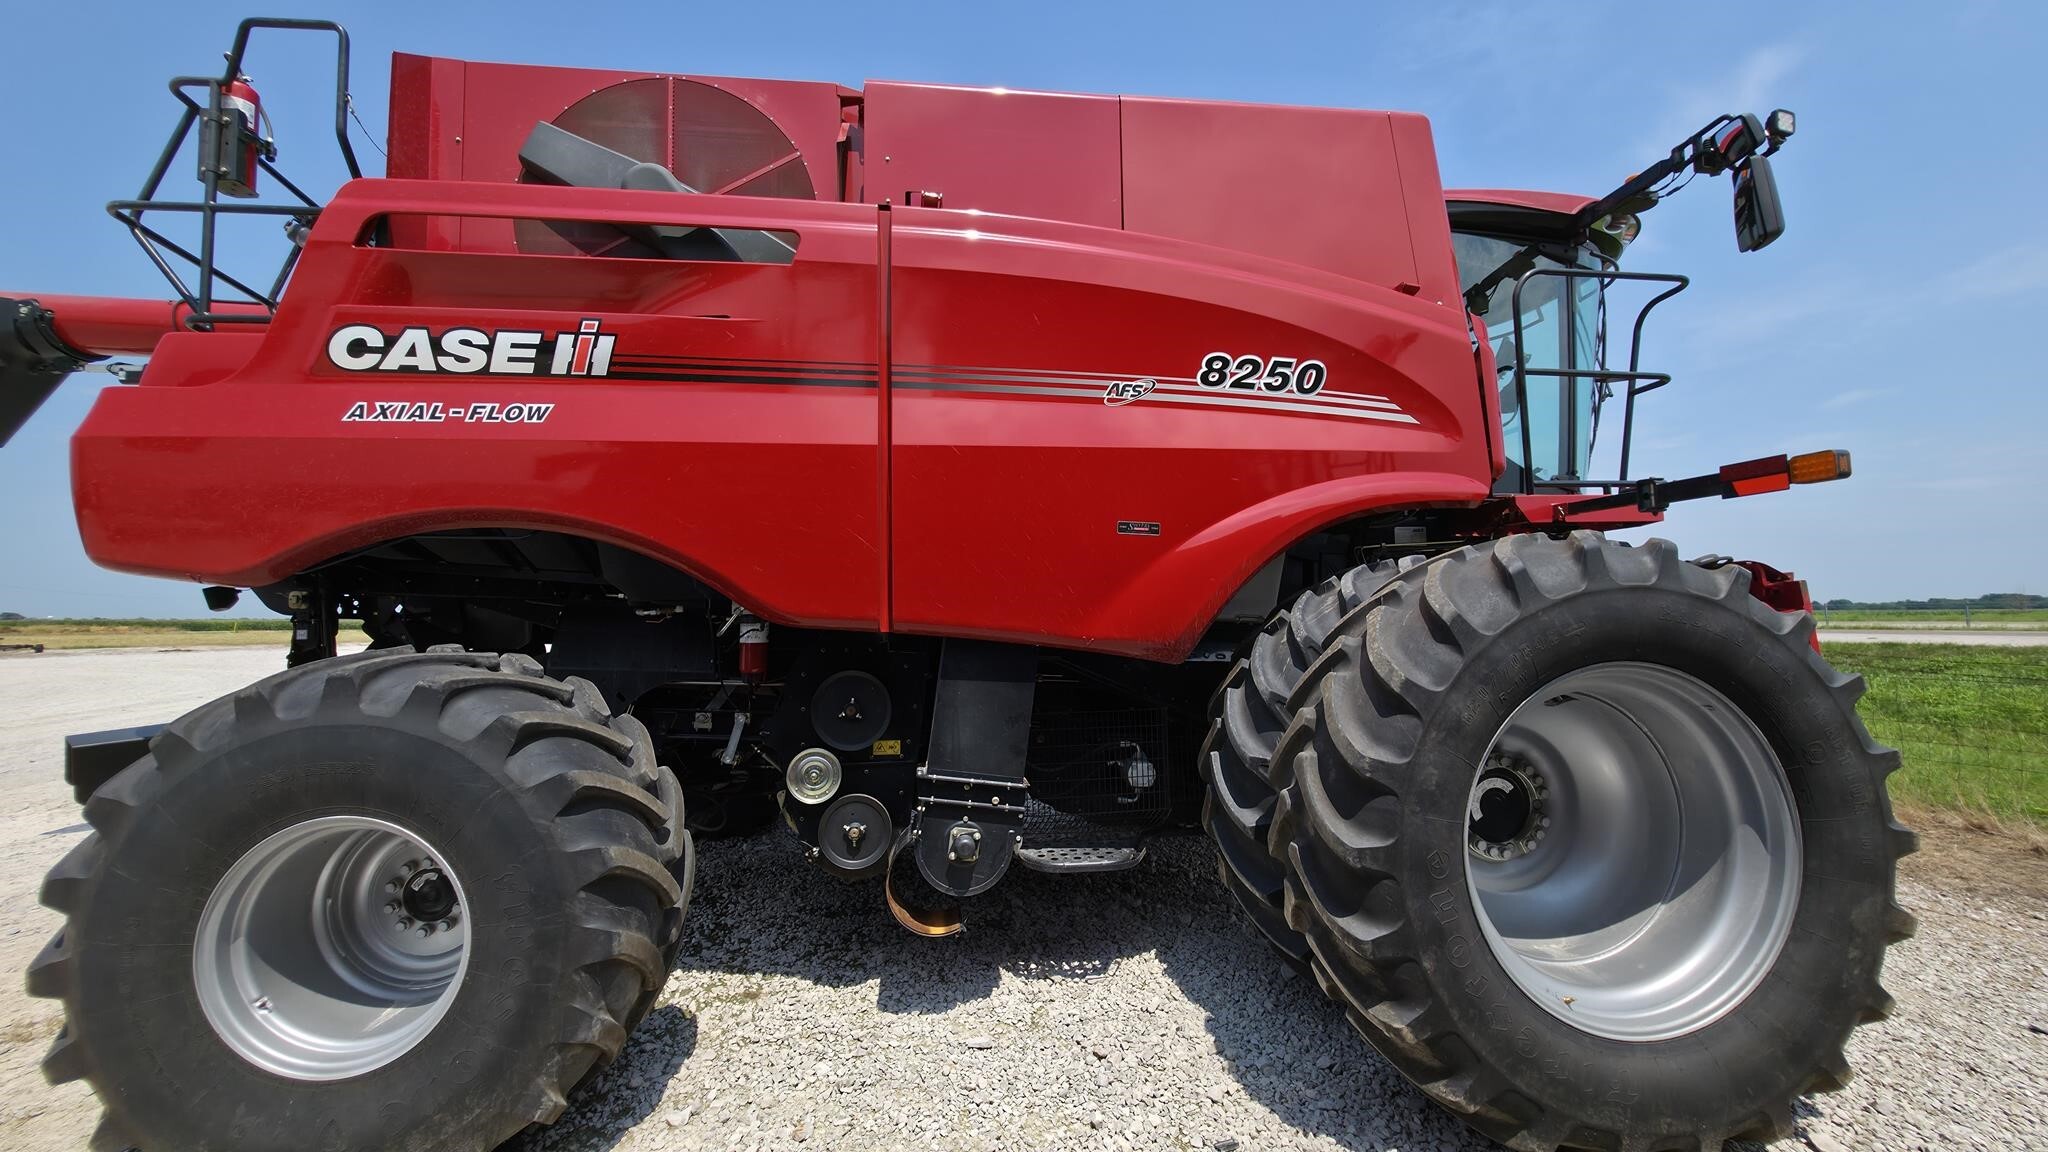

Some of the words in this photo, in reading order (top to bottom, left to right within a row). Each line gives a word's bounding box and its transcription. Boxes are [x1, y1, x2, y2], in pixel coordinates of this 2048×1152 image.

[328, 325, 543, 374] CASE
[1101, 381, 1146, 399] AFS
[1197, 352, 1327, 396] 8250
